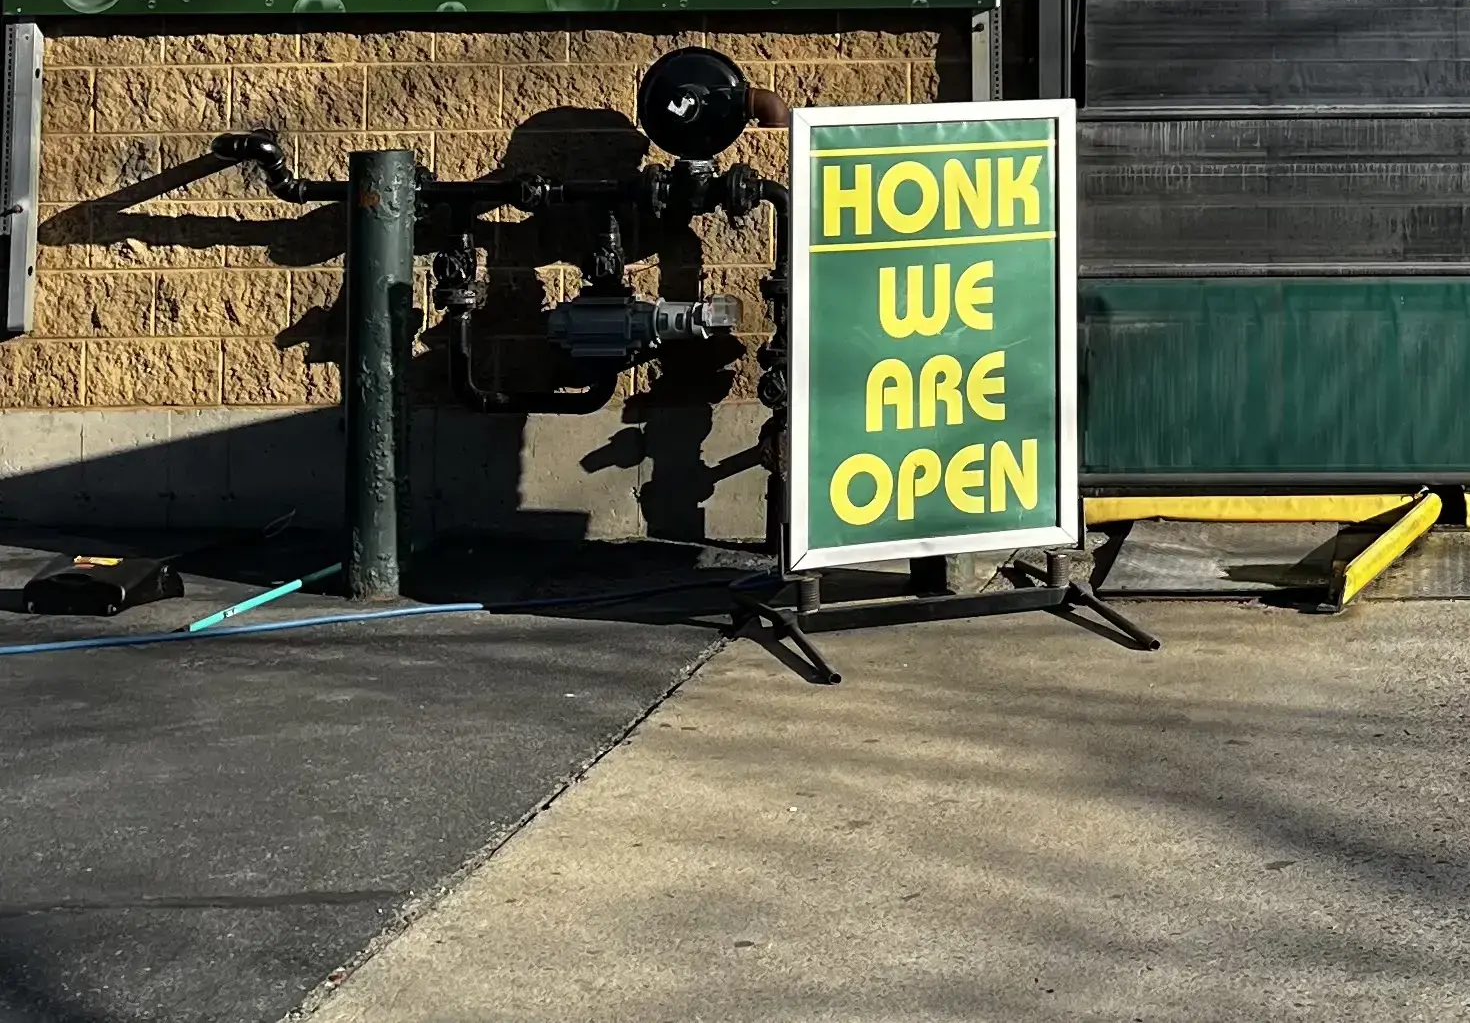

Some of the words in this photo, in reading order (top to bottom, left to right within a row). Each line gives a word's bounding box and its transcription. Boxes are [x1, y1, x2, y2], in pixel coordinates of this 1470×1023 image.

[823, 155, 1042, 236] HONK
[879, 260, 994, 338] WE
[866, 351, 1005, 432] ARE
[830, 439, 1037, 526] OPEN
